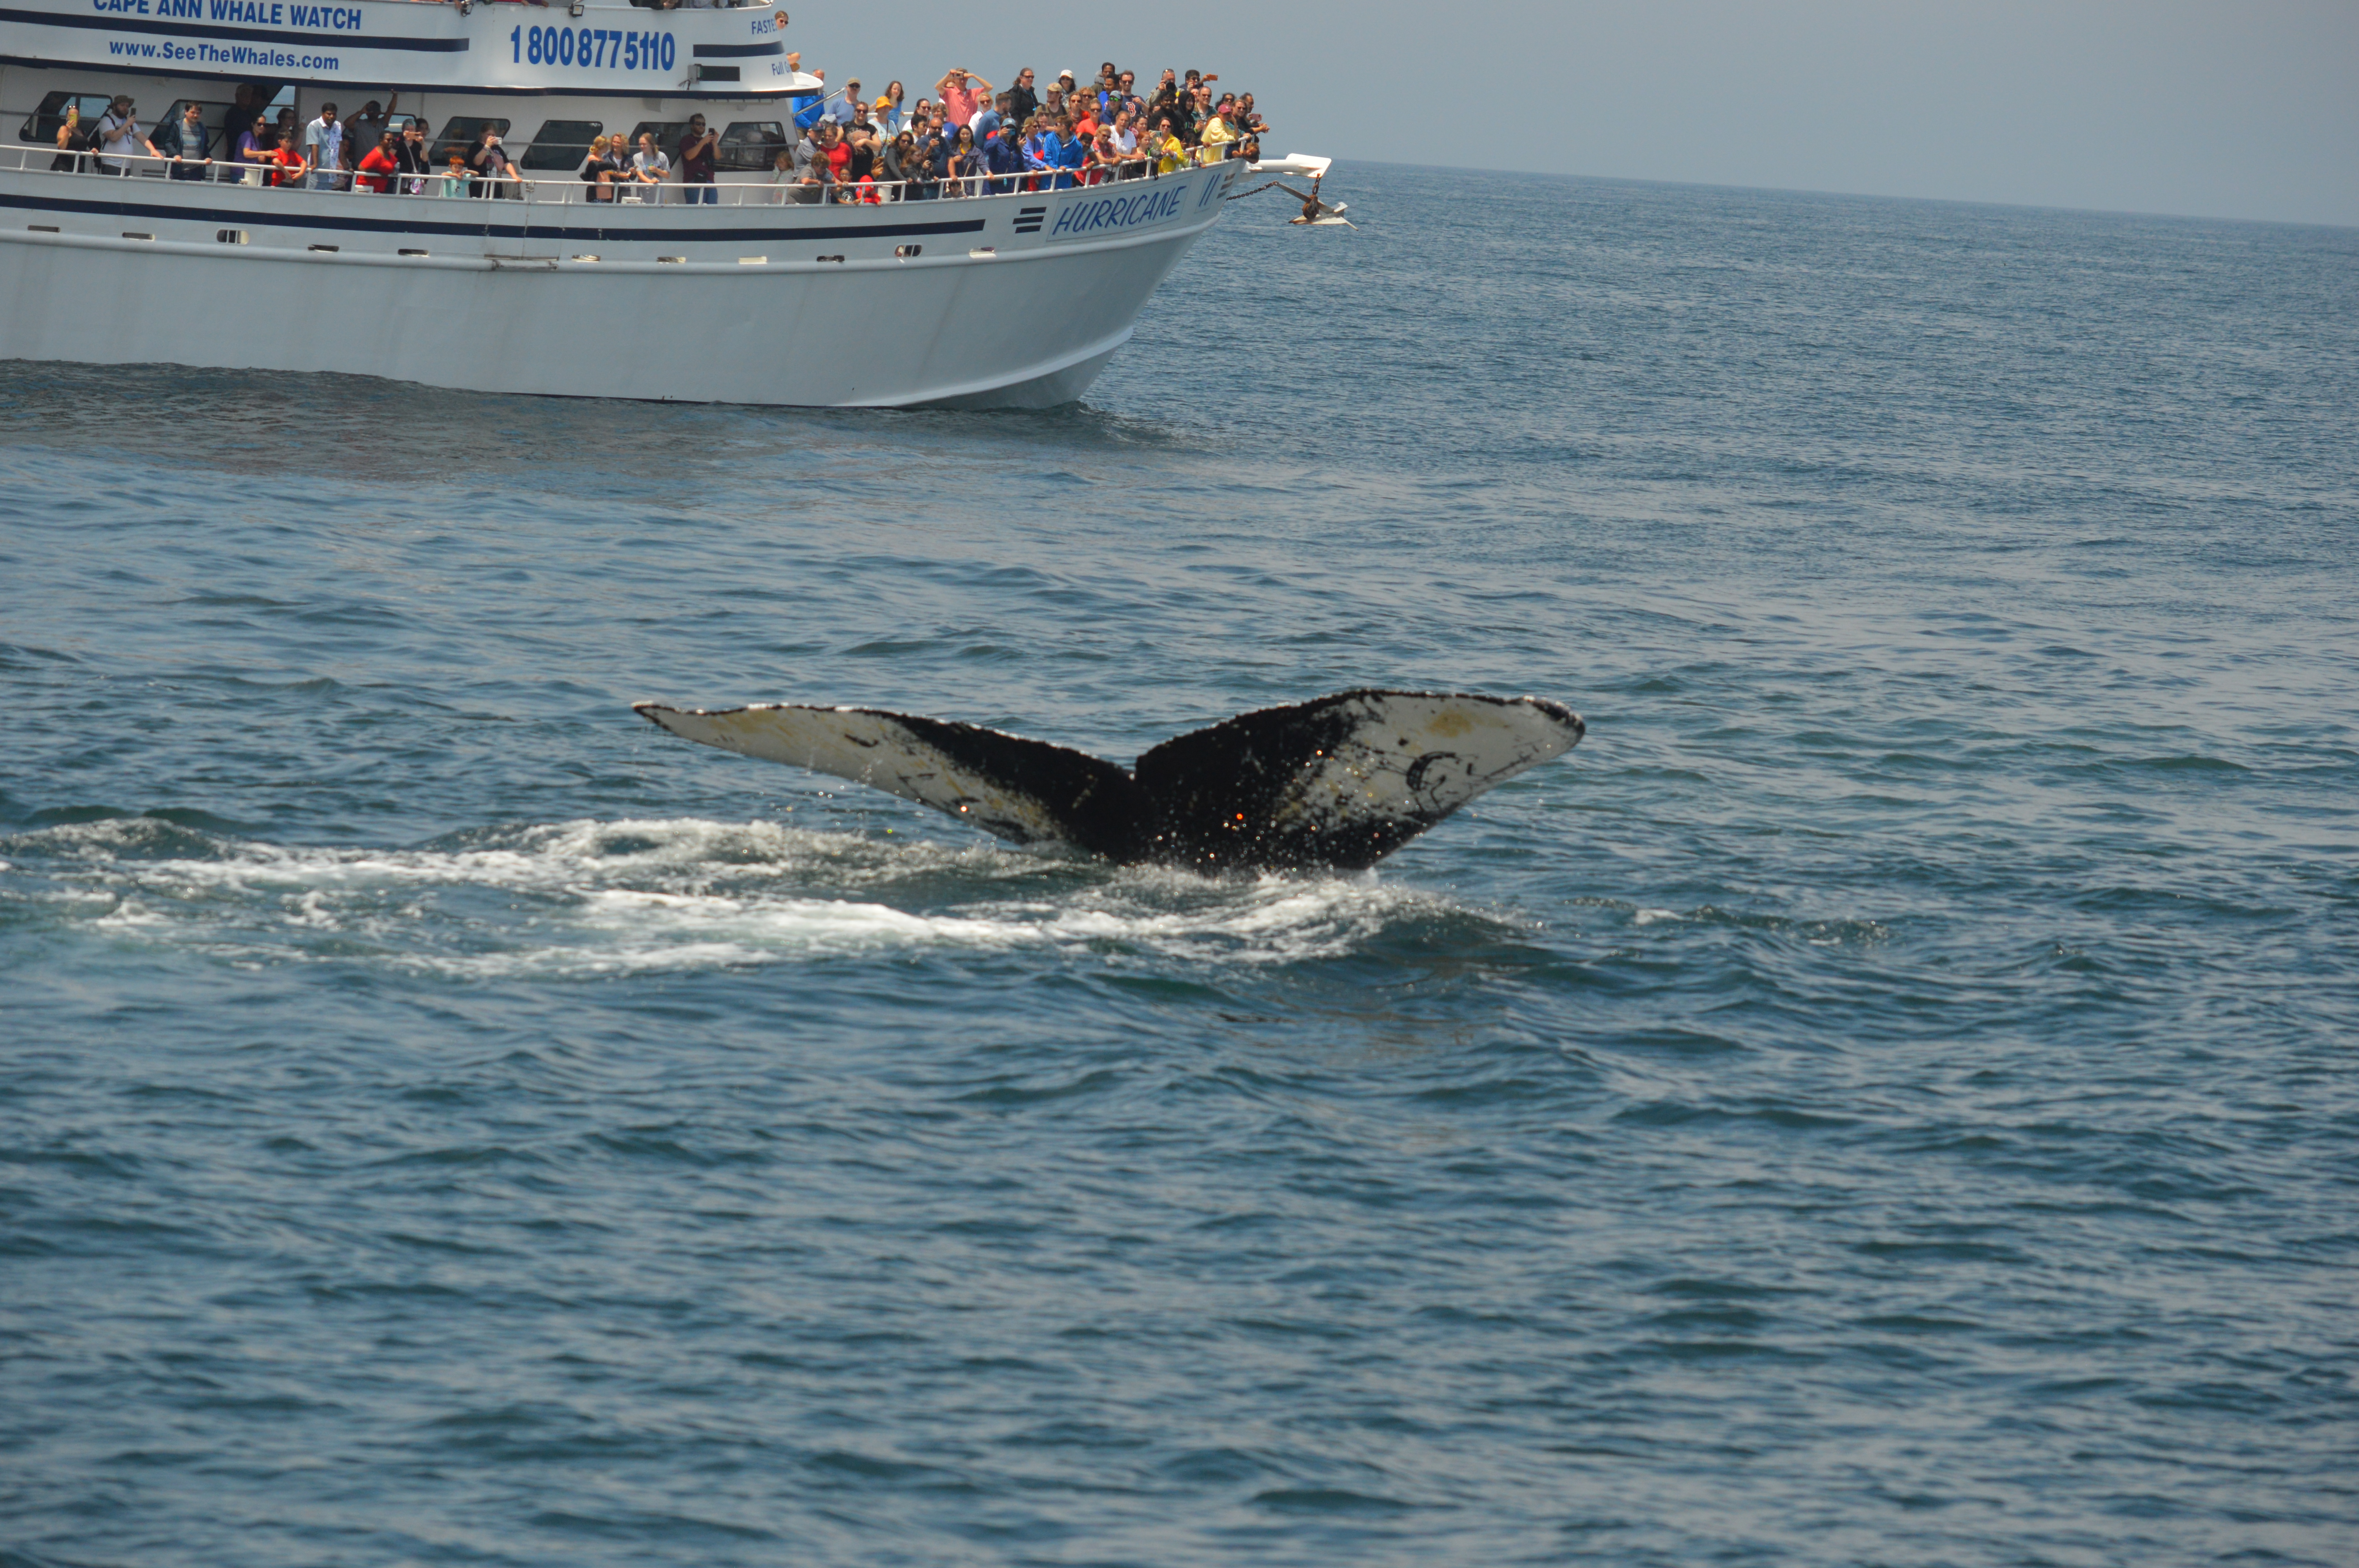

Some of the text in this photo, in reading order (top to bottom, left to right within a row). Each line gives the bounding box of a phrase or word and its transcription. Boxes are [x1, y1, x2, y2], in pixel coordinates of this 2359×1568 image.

[156, 0, 202, 18] ANN
[210, 0, 283, 25] WHALE
[290, 5, 362, 30] WATCH
[109, 41, 339, 70] www.SeeTheWhales.com
[771, 62, 785, 76] Full
[1126, 102, 1136, 117] B
[1052, 185, 1187, 236] HURRICANE
